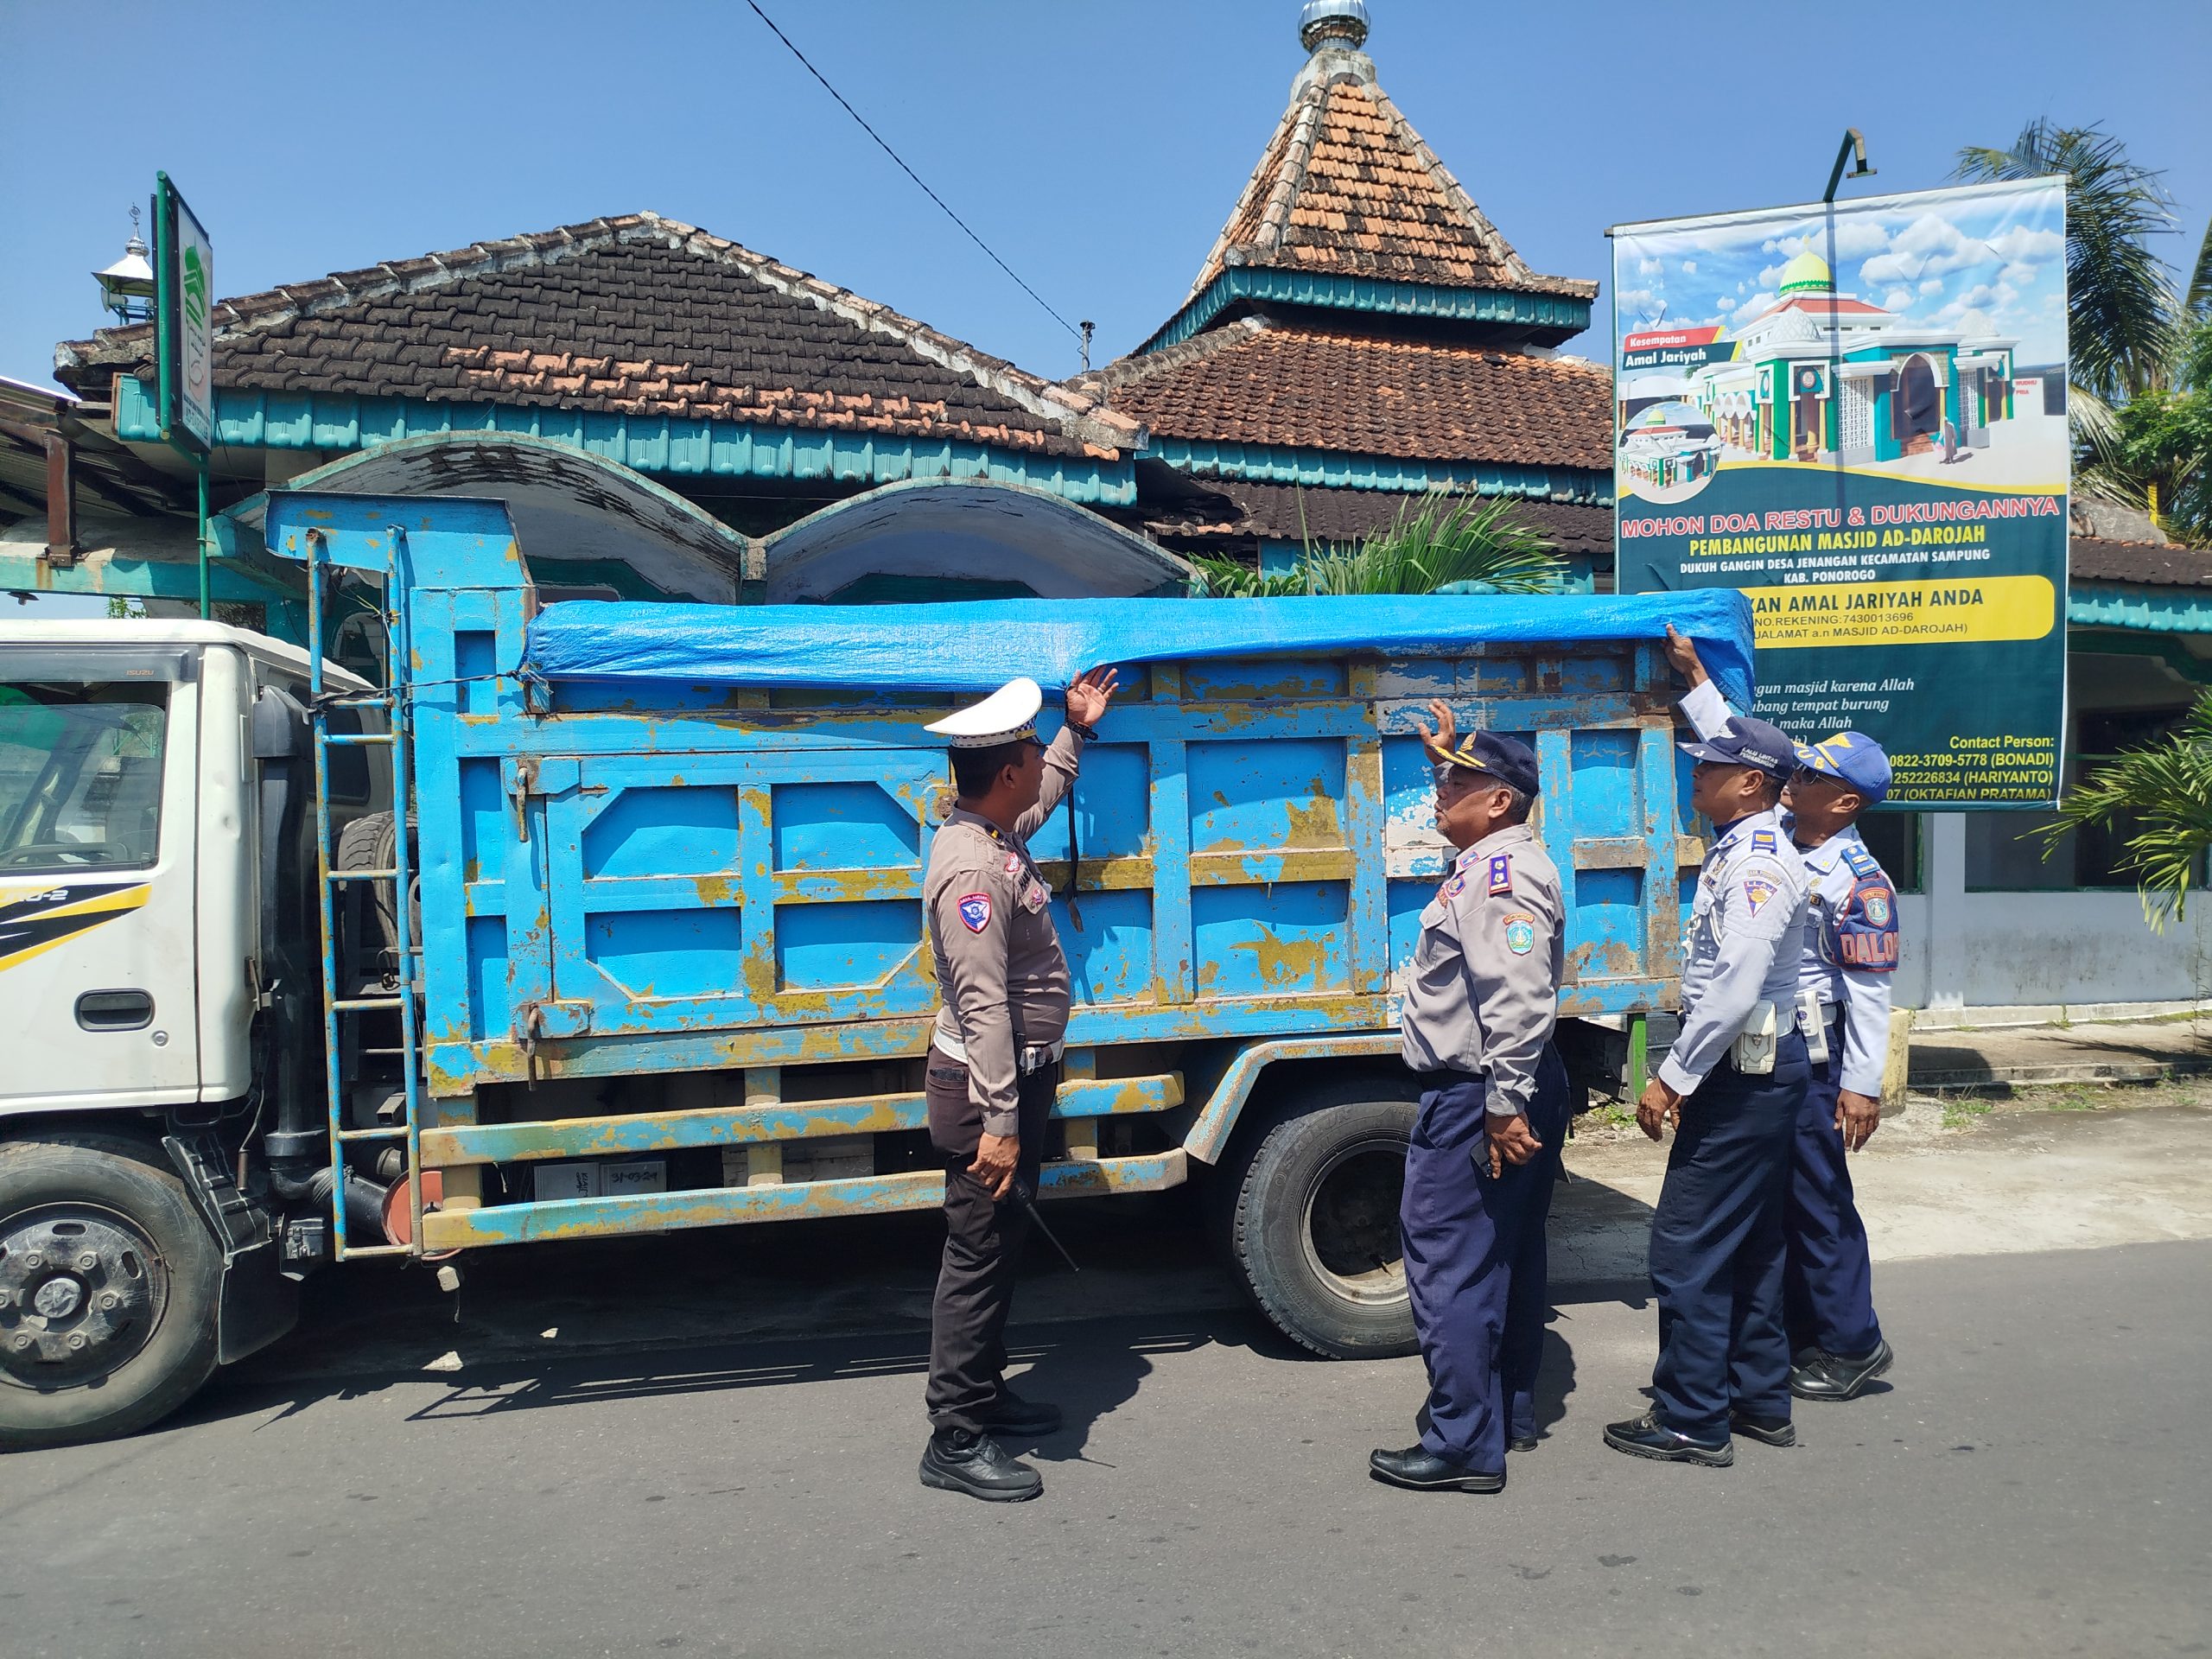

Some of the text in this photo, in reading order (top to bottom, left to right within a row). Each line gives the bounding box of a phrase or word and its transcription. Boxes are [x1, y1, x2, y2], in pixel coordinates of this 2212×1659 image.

[1630, 335, 1687, 347] Kesempatan
[1625, 347, 1707, 366] Amal Jariyah
[1621, 497, 2059, 538] MOHON DOA RESTU & DUKUNGANNYA
[1689, 525, 1986, 556] PEMBANGUNAN MASJID AD-DAROJAH
[1680, 549, 1991, 574] DUKUH GANGIN DESA JENANGAN KECAMATAN SAMPUNG
[1783, 569, 1876, 583] KAB. PONOROGO
[1788, 594, 1839, 612] AMAL
[1845, 591, 1923, 610] JARIYAH
[1929, 588, 1984, 607] ANDA
[1833, 626, 1878, 637] MASJID
[1881, 623, 1967, 635] AD-DAROJAH)
[1784, 681, 1828, 696] masjid
[1830, 681, 1876, 693] karena
[1879, 678, 1915, 691] Allah
[1791, 701, 1838, 714] tempat
[1840, 698, 1890, 712] burung
[1779, 717, 1815, 729] maka
[1817, 717, 1853, 729] Allah
[1949, 734, 2055, 749] Contact Person:
[1741, 747, 1778, 765] LALU LINTAS
[1889, 753, 2054, 768] 0822-3709-5778 (BONADI)
[1964, 771, 2053, 786] (HARIYANTO)
[1886, 788, 2051, 803] 07 (OKTAFIAN PRATAMA)
[1745, 880, 1776, 893] LLAJ
